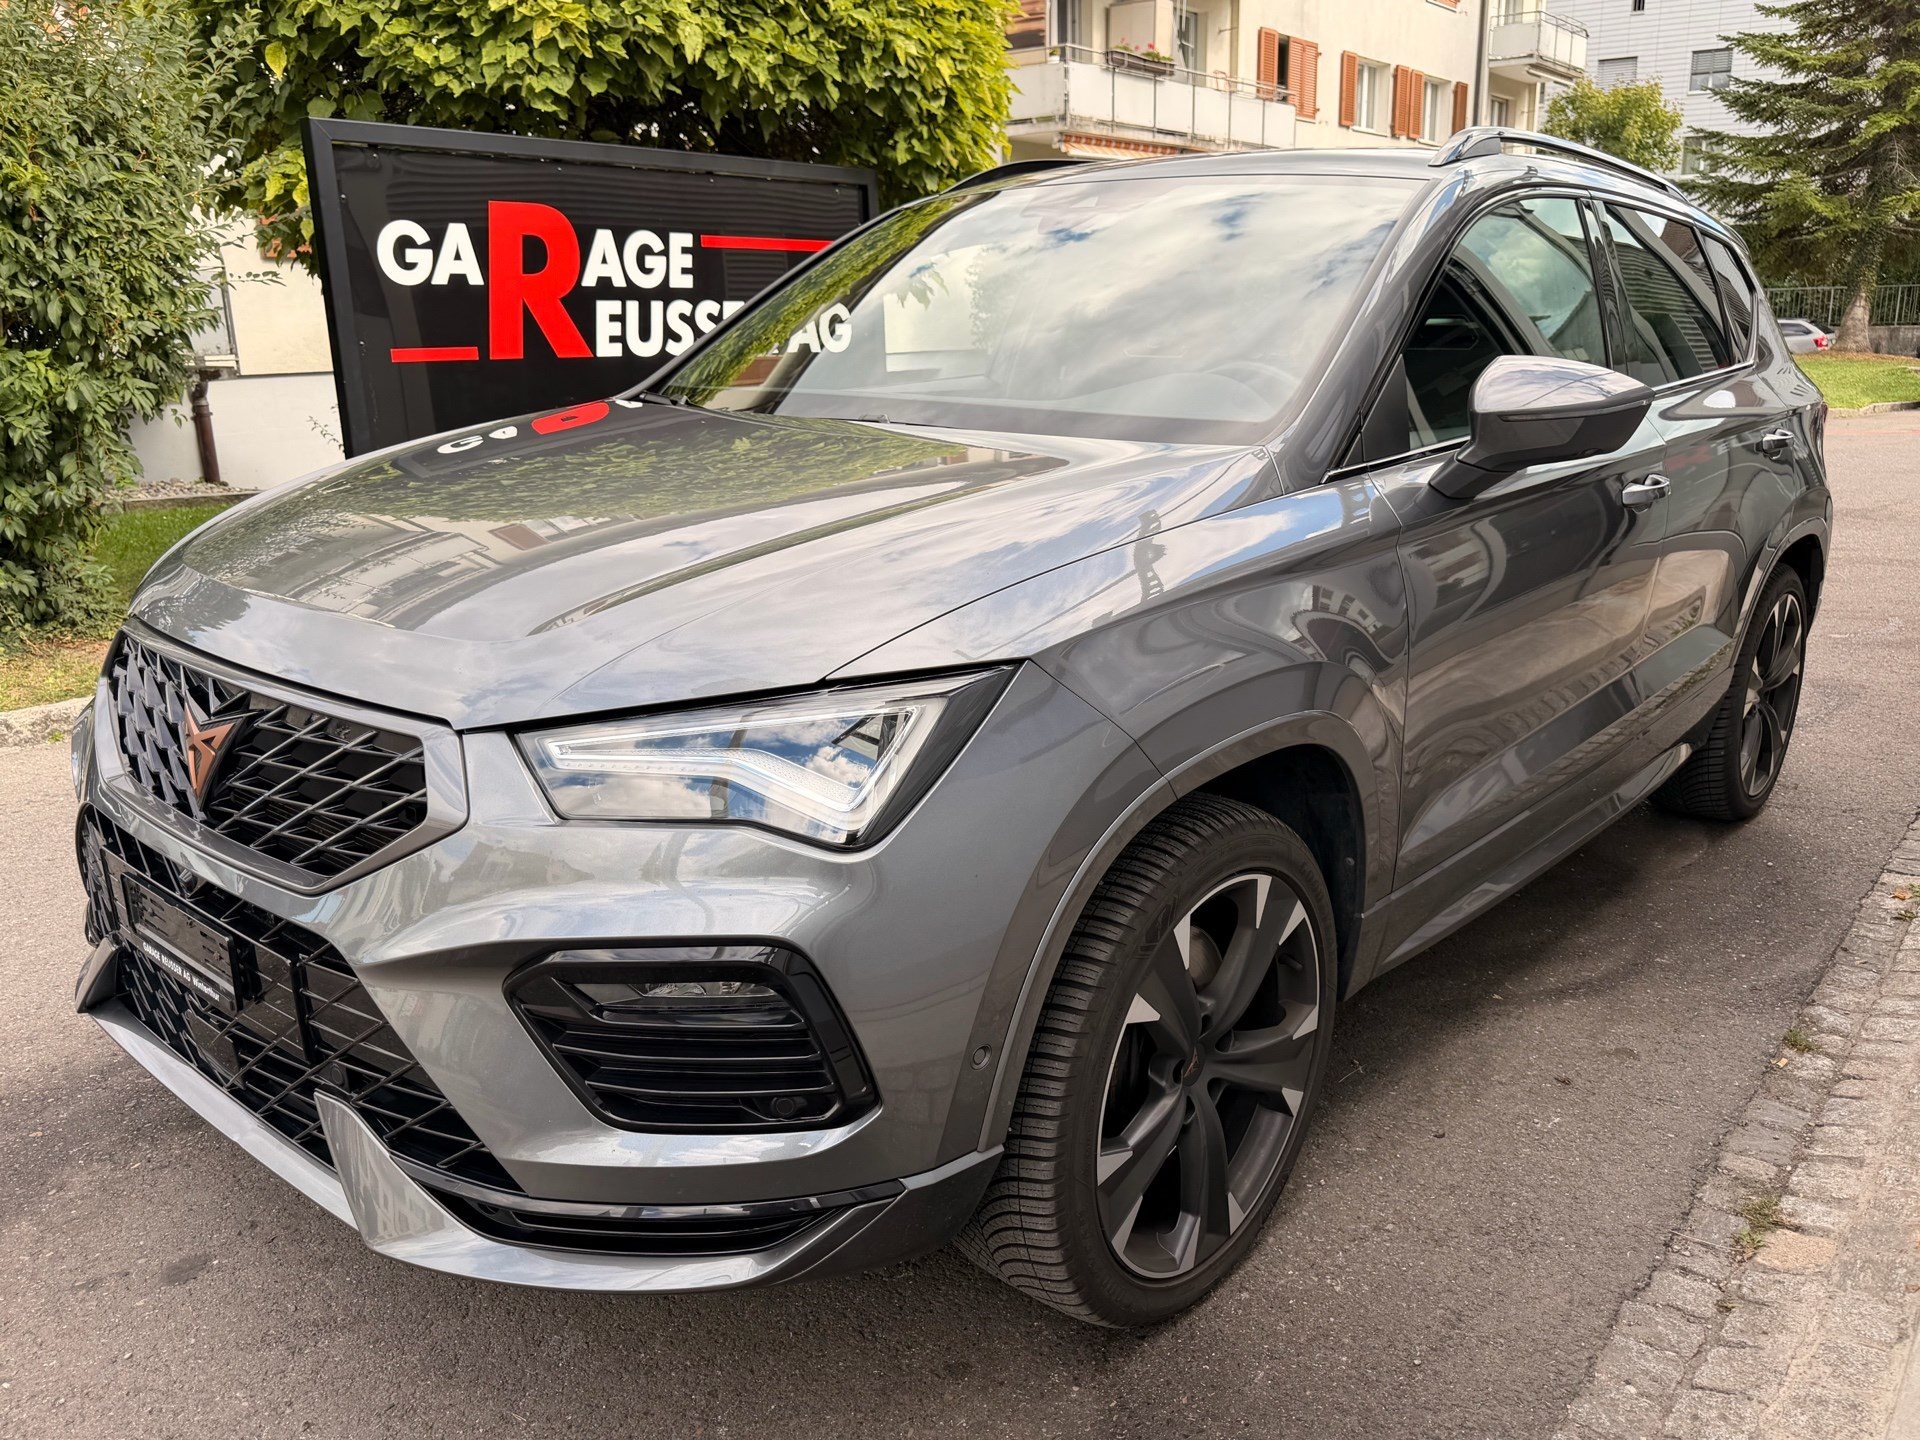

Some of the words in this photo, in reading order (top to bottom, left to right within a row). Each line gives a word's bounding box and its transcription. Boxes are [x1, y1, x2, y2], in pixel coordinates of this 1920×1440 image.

[376, 200, 694, 360] GARAGE
[787, 302, 853, 353] AG
[143, 941, 161, 961] GARAGE
[183, 969, 191, 982] AG
